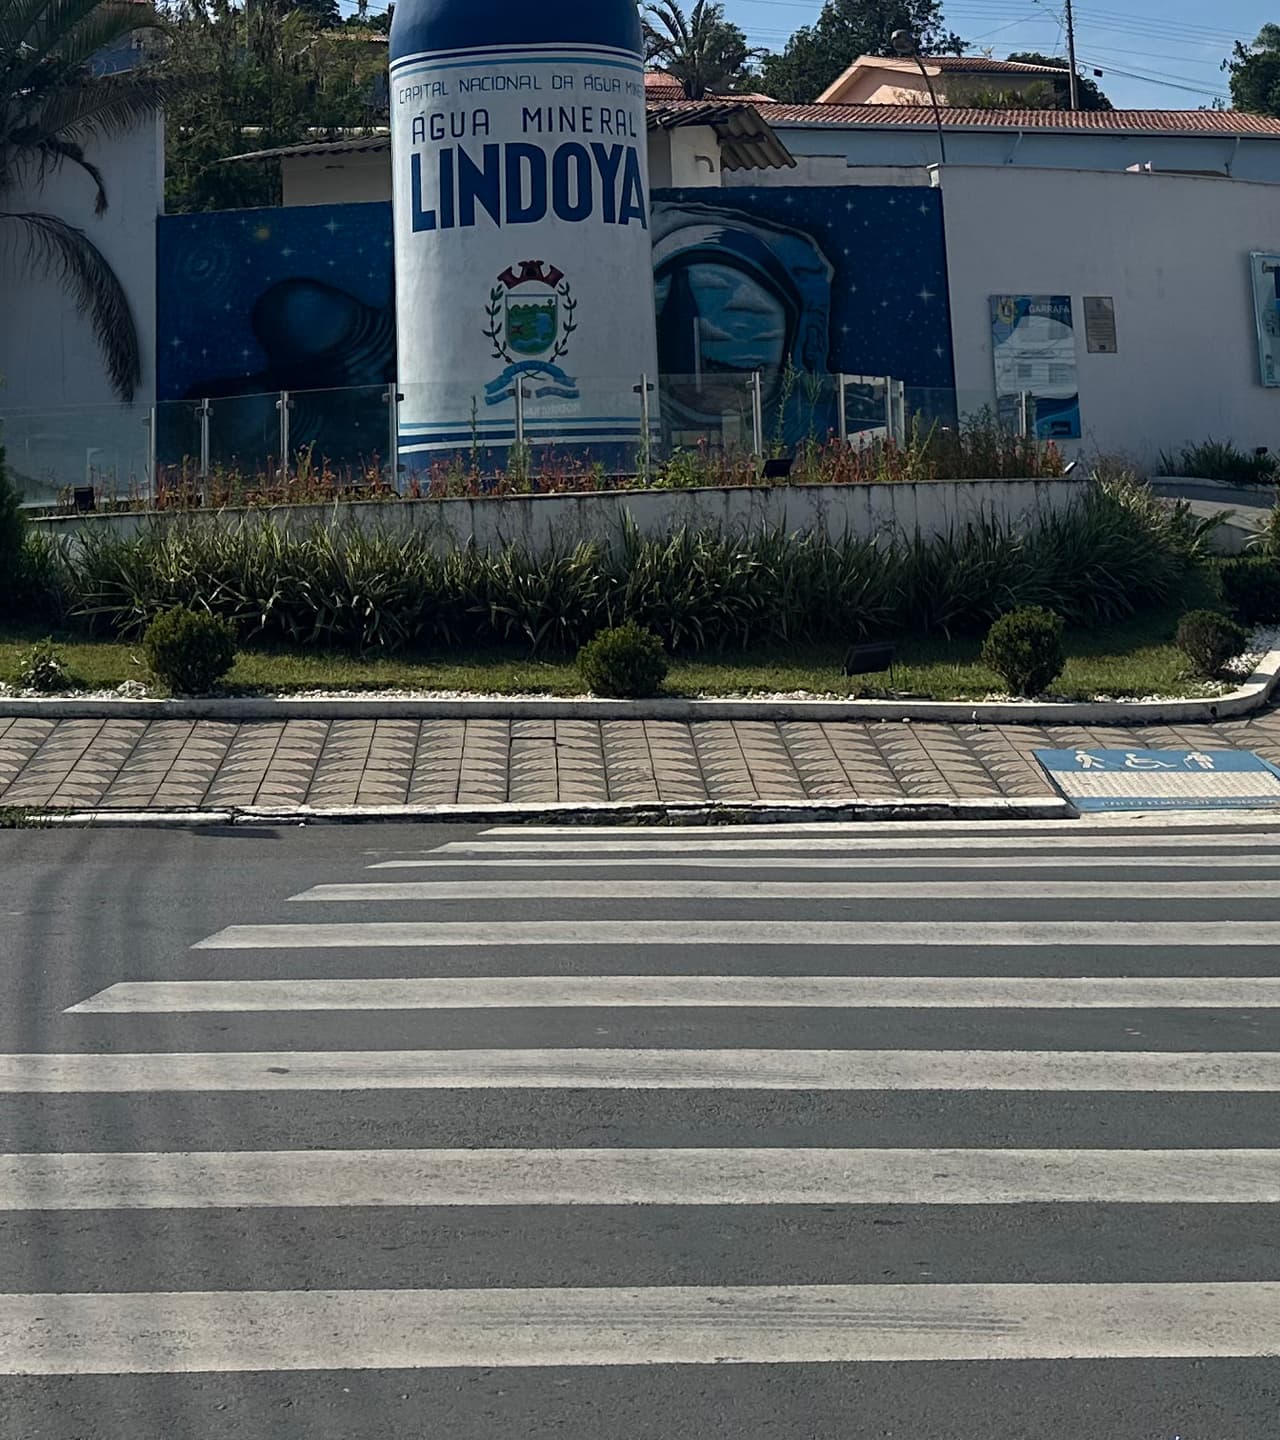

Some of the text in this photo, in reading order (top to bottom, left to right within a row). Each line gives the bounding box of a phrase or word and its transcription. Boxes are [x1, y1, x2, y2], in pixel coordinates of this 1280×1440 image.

[399, 81, 449, 104] CAPITAL
[459, 75, 543, 93] NACIONAL
[551, 75, 574, 90] DA
[583, 73, 621, 93] ÁGUA
[412, 107, 638, 145] ÁGUA MINERAL
[411, 142, 648, 233] LINDOYA
[1028, 303, 1070, 314] GARRAFA
